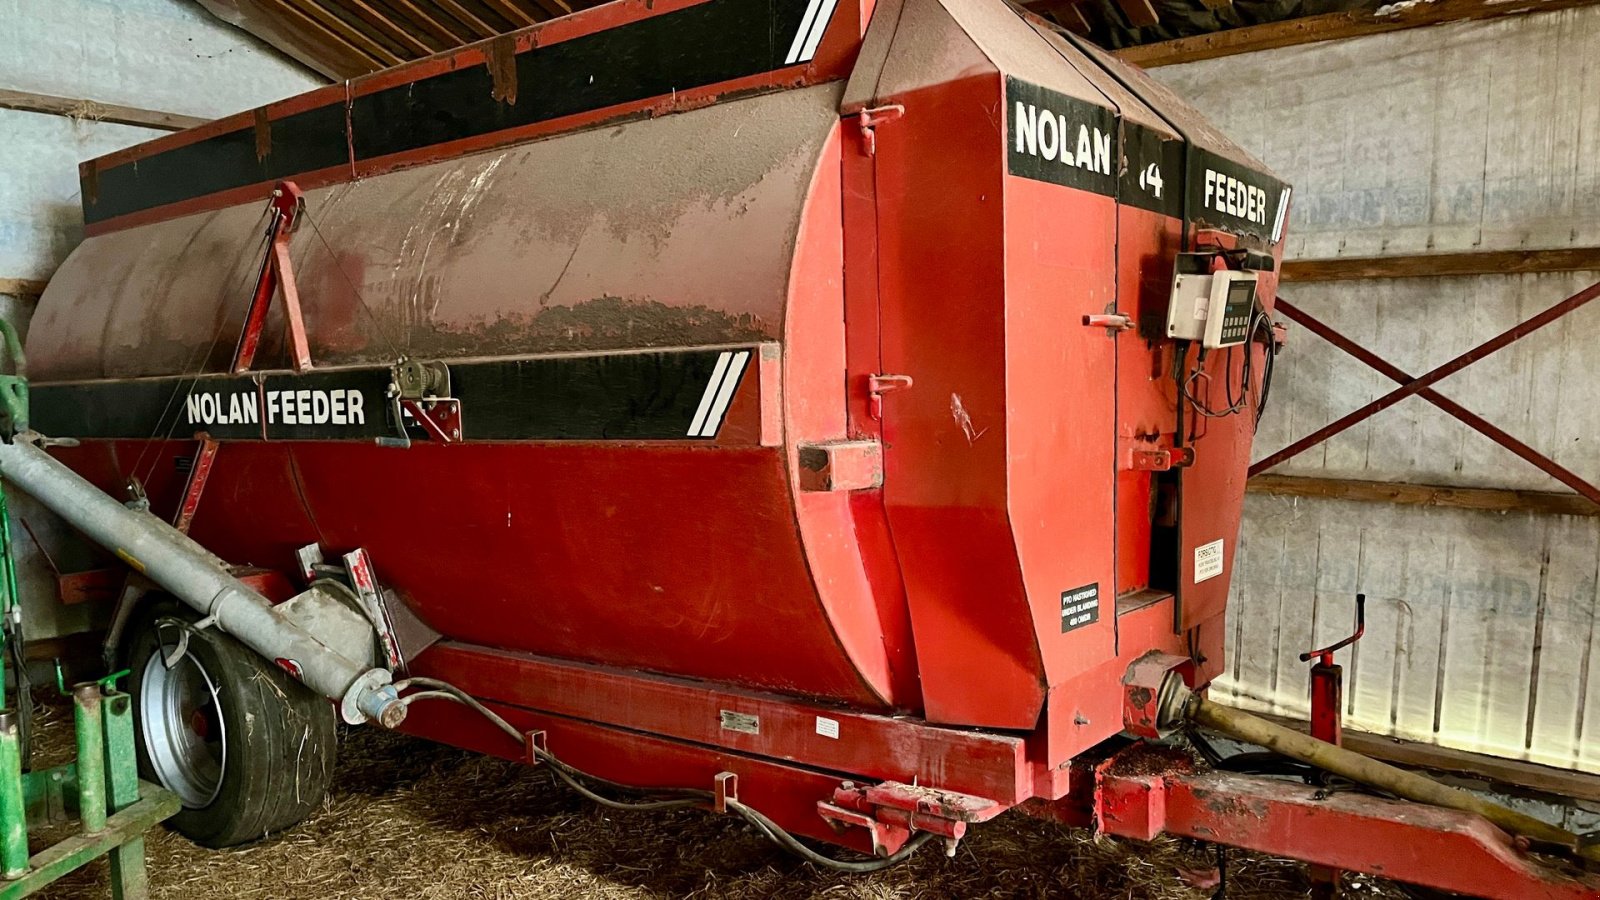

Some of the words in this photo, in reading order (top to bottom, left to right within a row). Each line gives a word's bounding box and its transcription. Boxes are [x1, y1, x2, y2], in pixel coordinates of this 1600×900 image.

[1016, 101, 1111, 175] NOLAN
[1204, 168, 1266, 226] FEEDER
[187, 391, 258, 425] NOLAN
[267, 389, 365, 425] FEEDER
[1062, 606, 1077, 617] UNDER
